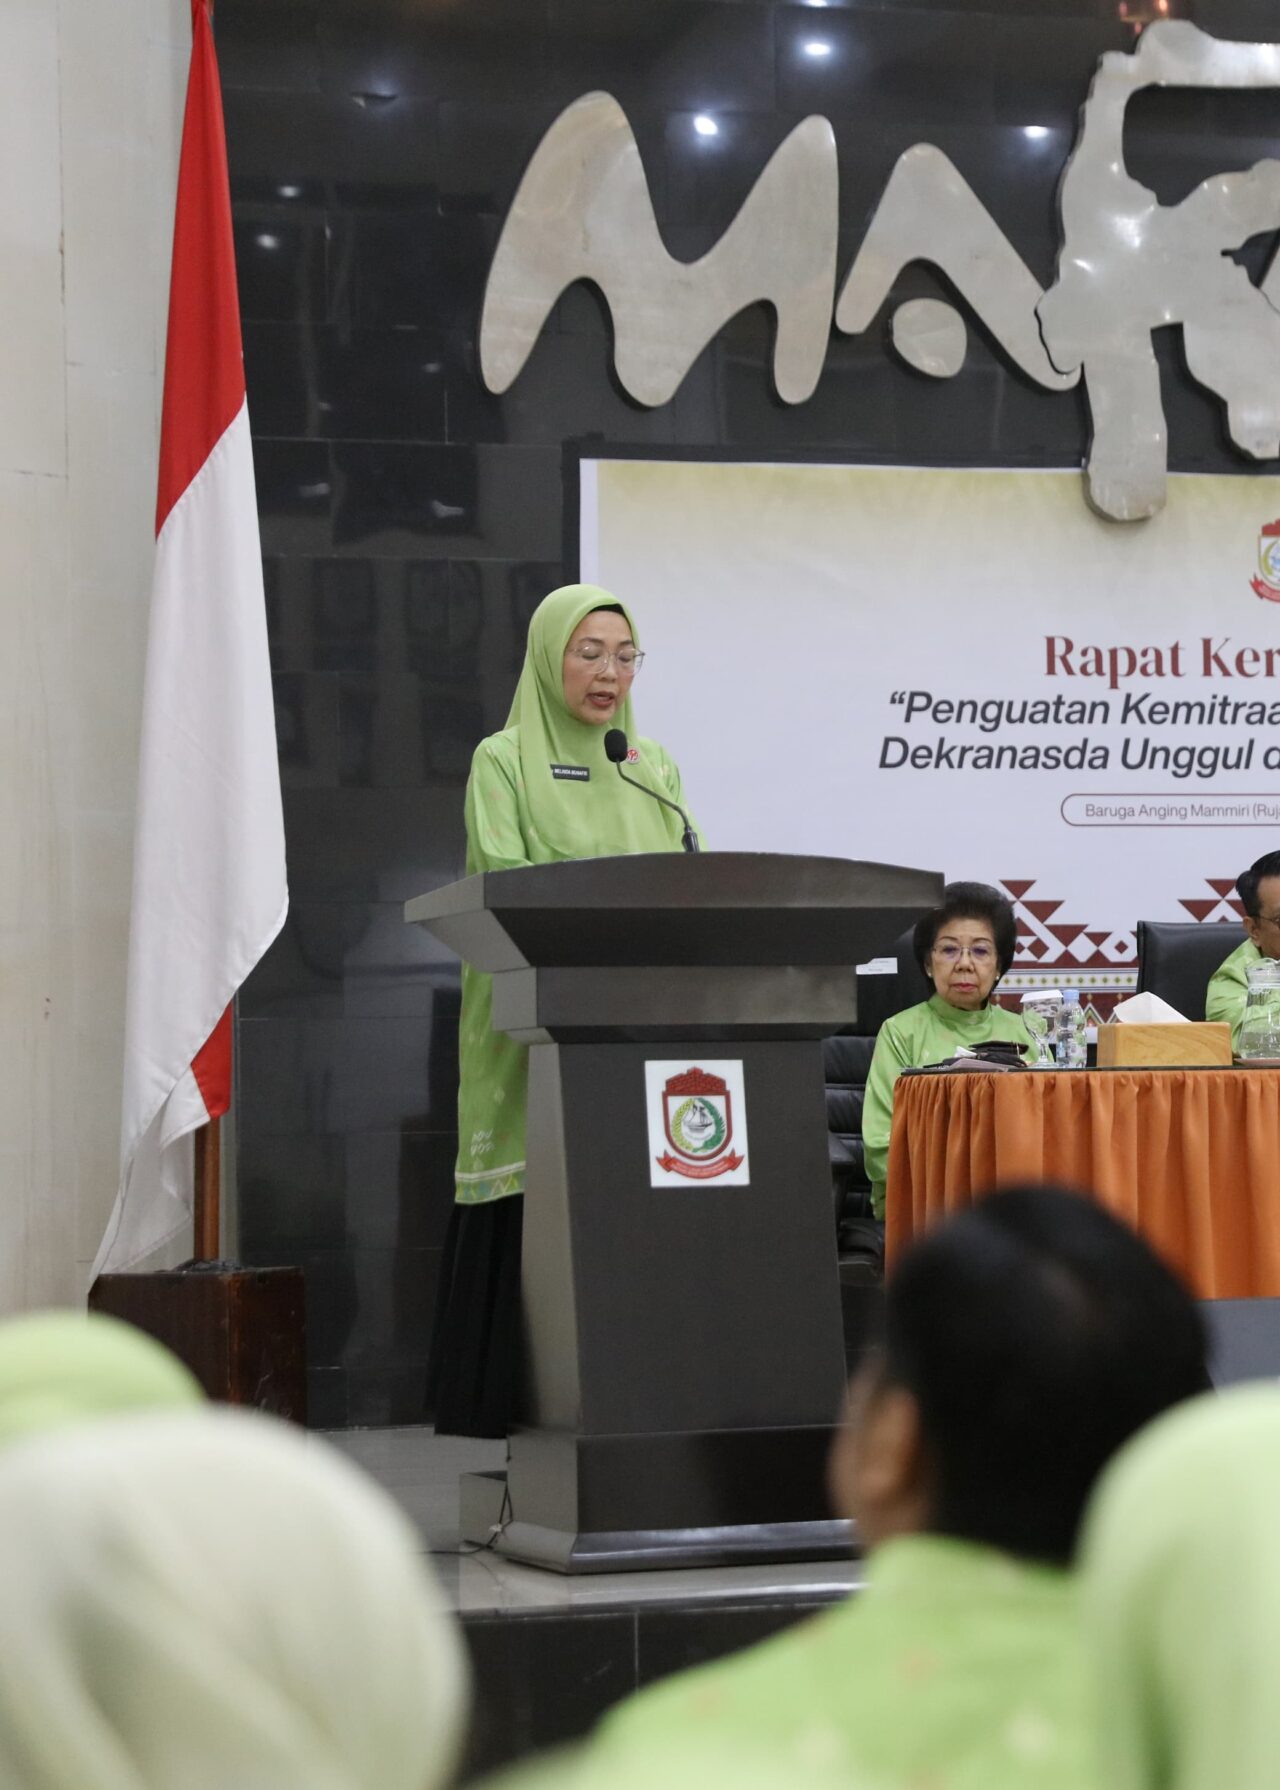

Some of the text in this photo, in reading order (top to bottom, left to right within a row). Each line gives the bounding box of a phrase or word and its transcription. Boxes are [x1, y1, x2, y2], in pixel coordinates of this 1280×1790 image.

[1045, 635, 1185, 690] Rapat
[878, 736, 1110, 770] Dekranasda
[1120, 738, 1254, 779] Unggul
[1085, 803, 1136, 820] Baruga
[1138, 803, 1188, 821] Anging
[1190, 803, 1250, 818] Mammiri
